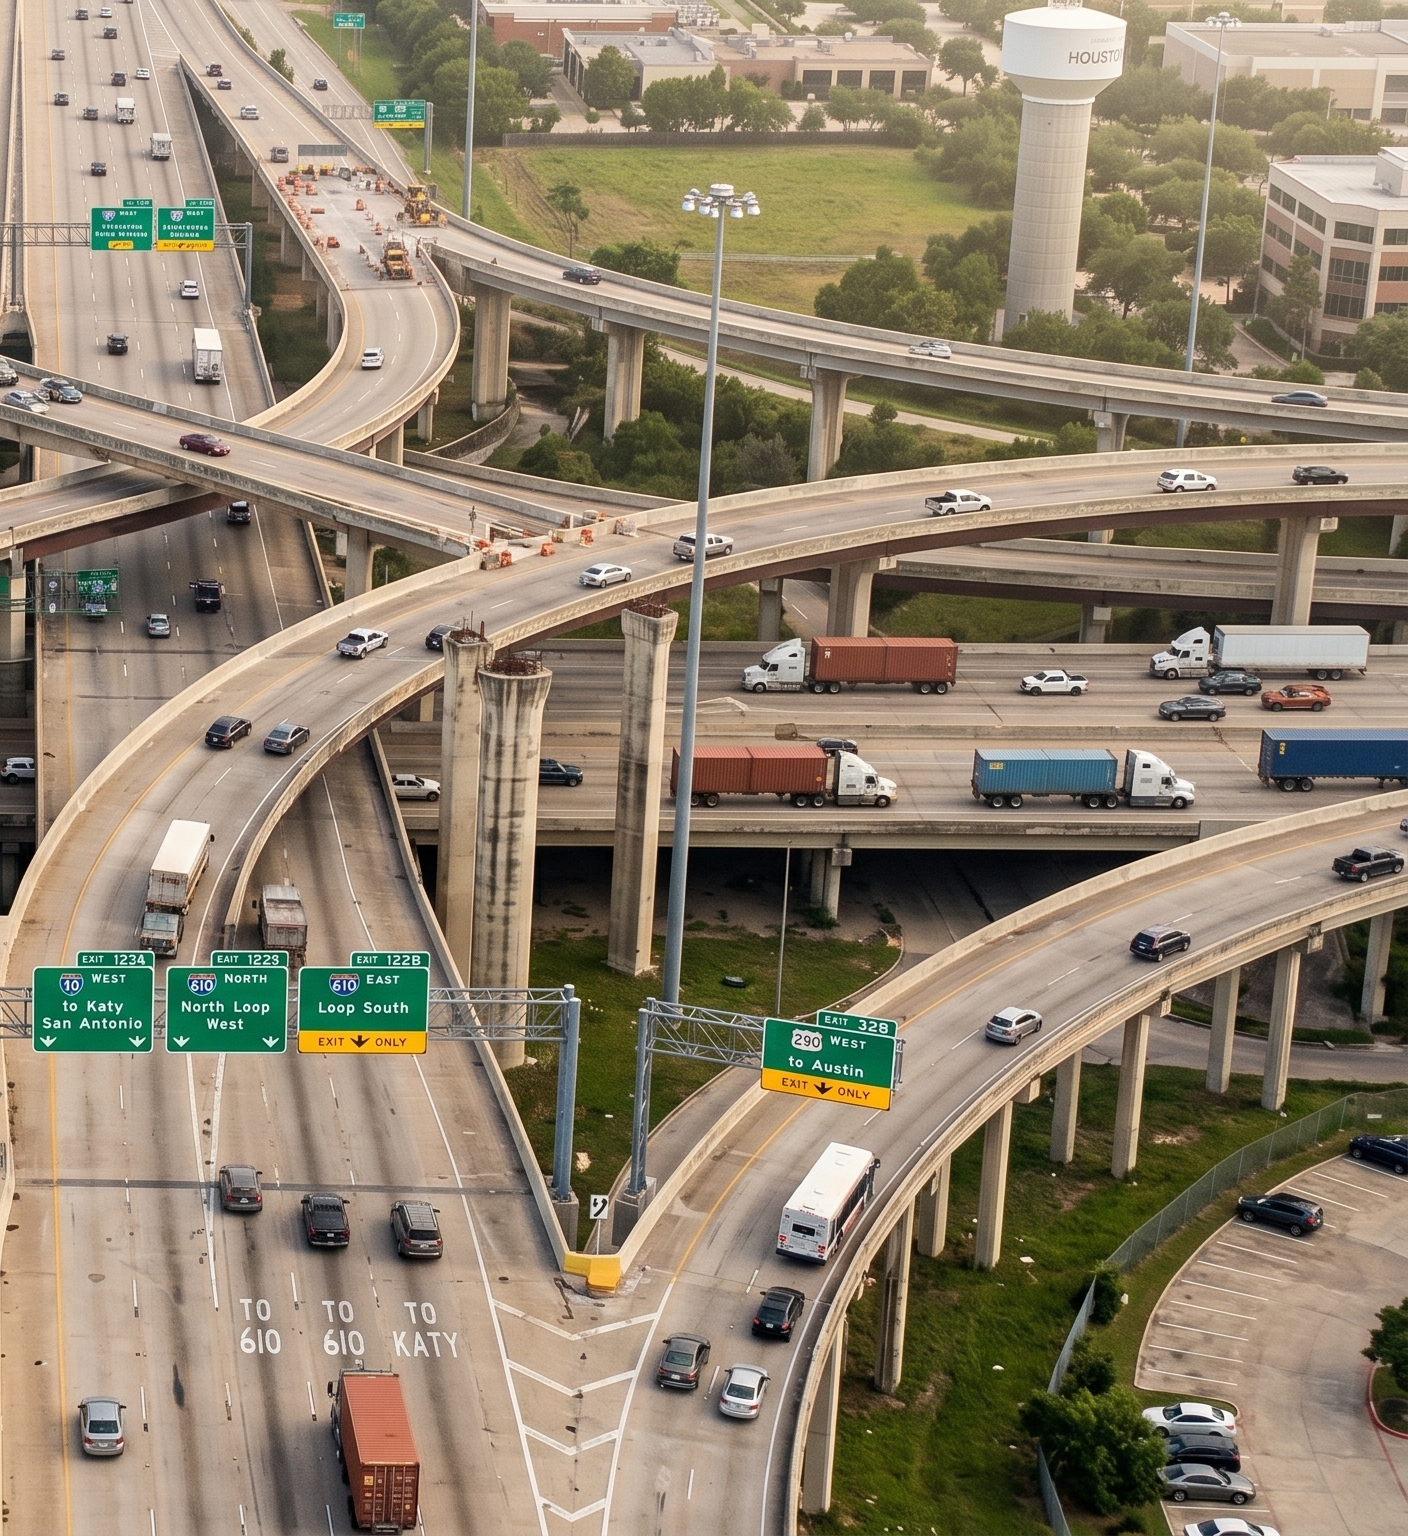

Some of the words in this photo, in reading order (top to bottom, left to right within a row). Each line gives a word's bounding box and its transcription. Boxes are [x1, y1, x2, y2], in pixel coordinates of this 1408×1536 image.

[82, 955, 104, 964] EXIT
[387, 955, 421, 966] 122B
[63, 980, 80, 991] 10
[91, 973, 126, 984] WEST
[190, 980, 213, 991] 610
[224, 973, 267, 983] NORTH
[332, 980, 357, 991] 610
[366, 974, 400, 985] EAST
[62, 1000, 78, 1012] to
[87, 1000, 124, 1015] Katy
[181, 1000, 225, 1013] North
[233, 1000, 270, 1016] Loop
[318, 1001, 355, 1016] Loop
[363, 1001, 409, 1014] South
[42, 1017, 72, 1029] San
[79, 1017, 143, 1029] Antonio
[206, 1018, 244, 1030] West
[318, 1037, 345, 1047] EXIT
[375, 1037, 407, 1047] ONLY
[794, 1033, 821, 1049] 290
[830, 1035, 867, 1050] WEST
[788, 1056, 803, 1067] to
[811, 1059, 864, 1078] Austin
[782, 1077, 808, 1090] EXIT
[837, 1087, 870, 1100] ONLY
[239, 1298, 271, 1322] TO
[321, 1300, 355, 1323] TO
[403, 1302, 437, 1325] TO
[240, 1326, 282, 1354] 610
[323, 1328, 365, 1356] 610
[392, 1330, 458, 1358] KATY
